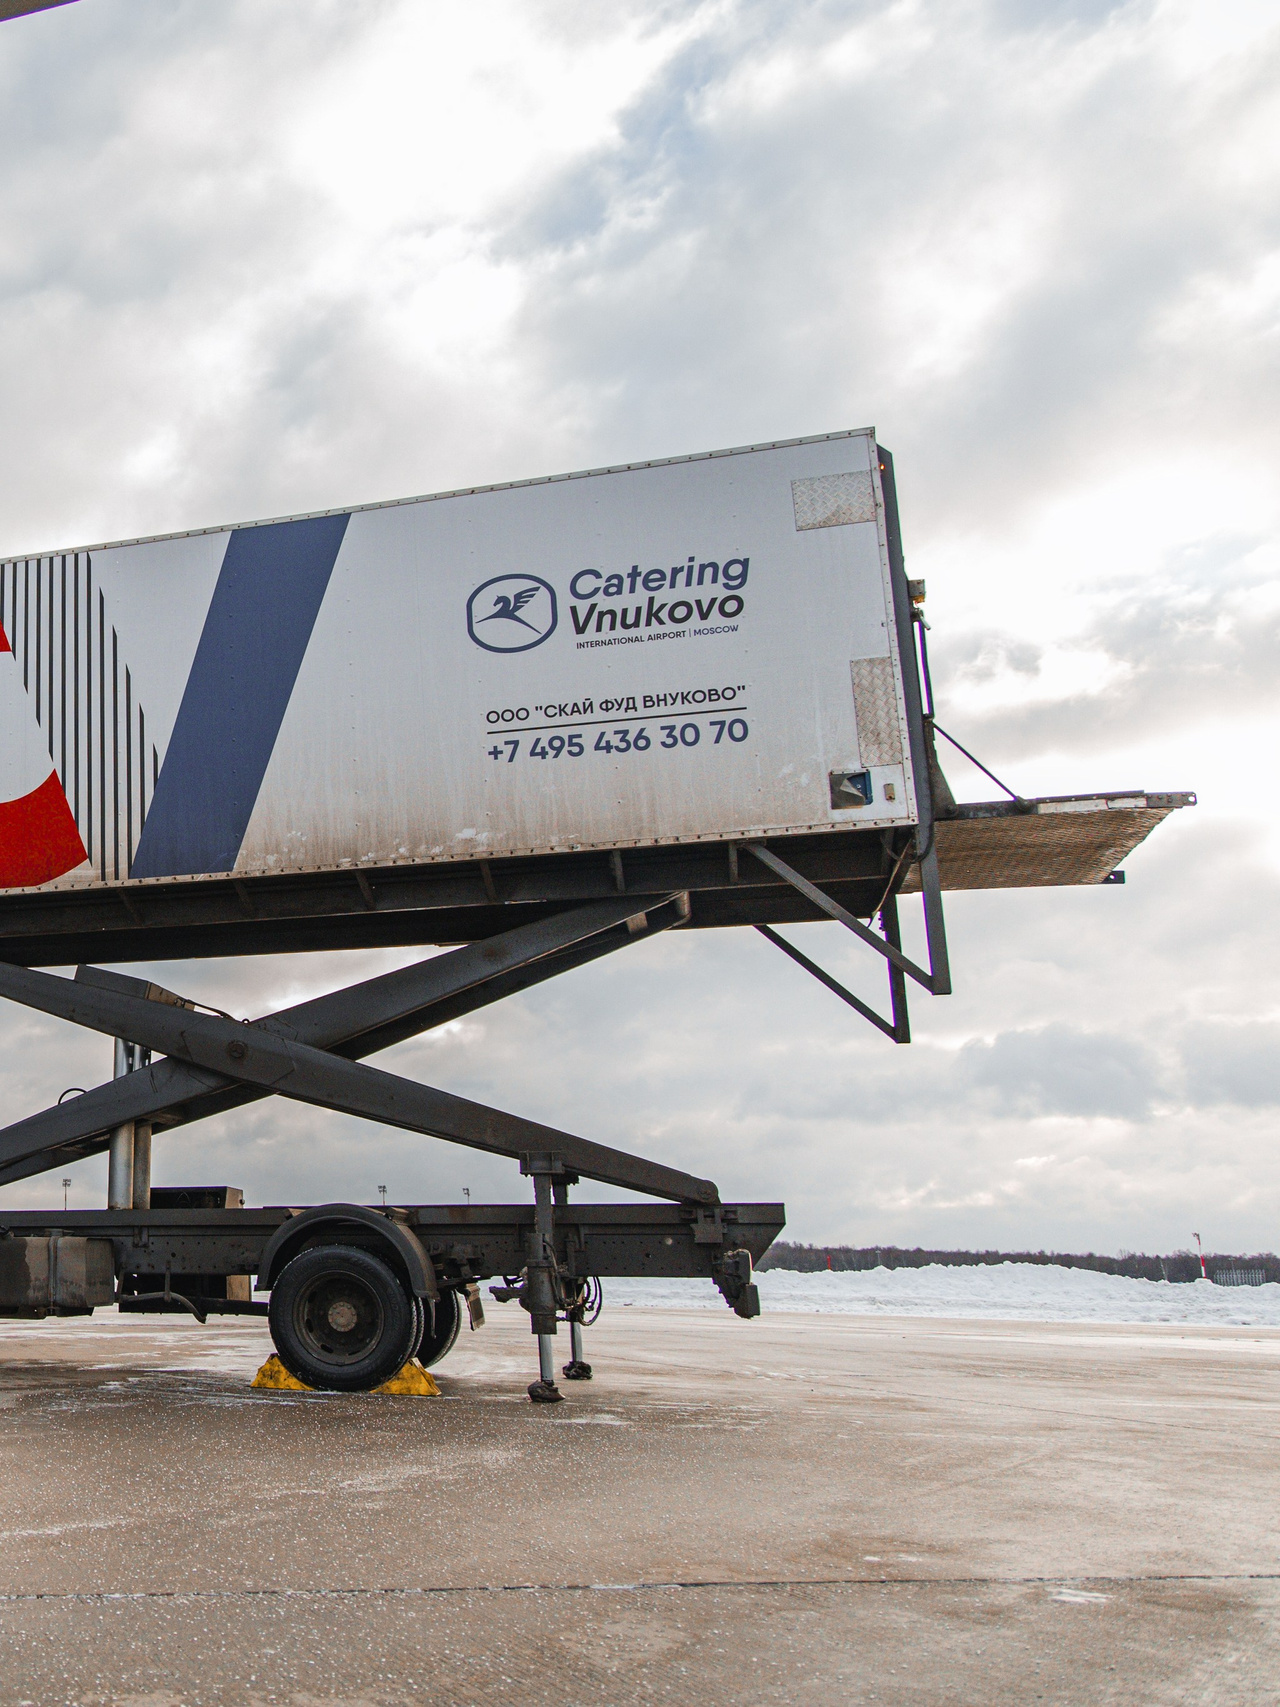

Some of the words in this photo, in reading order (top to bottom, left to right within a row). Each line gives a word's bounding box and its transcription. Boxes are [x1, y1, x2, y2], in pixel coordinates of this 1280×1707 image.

[570, 556, 750, 600] Catering
[570, 595, 745, 635] Vnukovo
[576, 634, 645, 649] INTERNATIONAL
[647, 630, 686, 642] AIRPORT
[693, 625, 739, 636] MOSCOW
[486, 707, 530, 723] ООО
[535, 698, 594, 718] "СКАЙ
[599, 696, 638, 713] ФУД
[643, 685, 746, 709] ВНУКОВО"
[488, 739, 520, 763] +7
[529, 733, 584, 760] 495
[594, 727, 651, 754] 436
[660, 722, 701, 749] 30
[709, 718, 749, 744] 70
